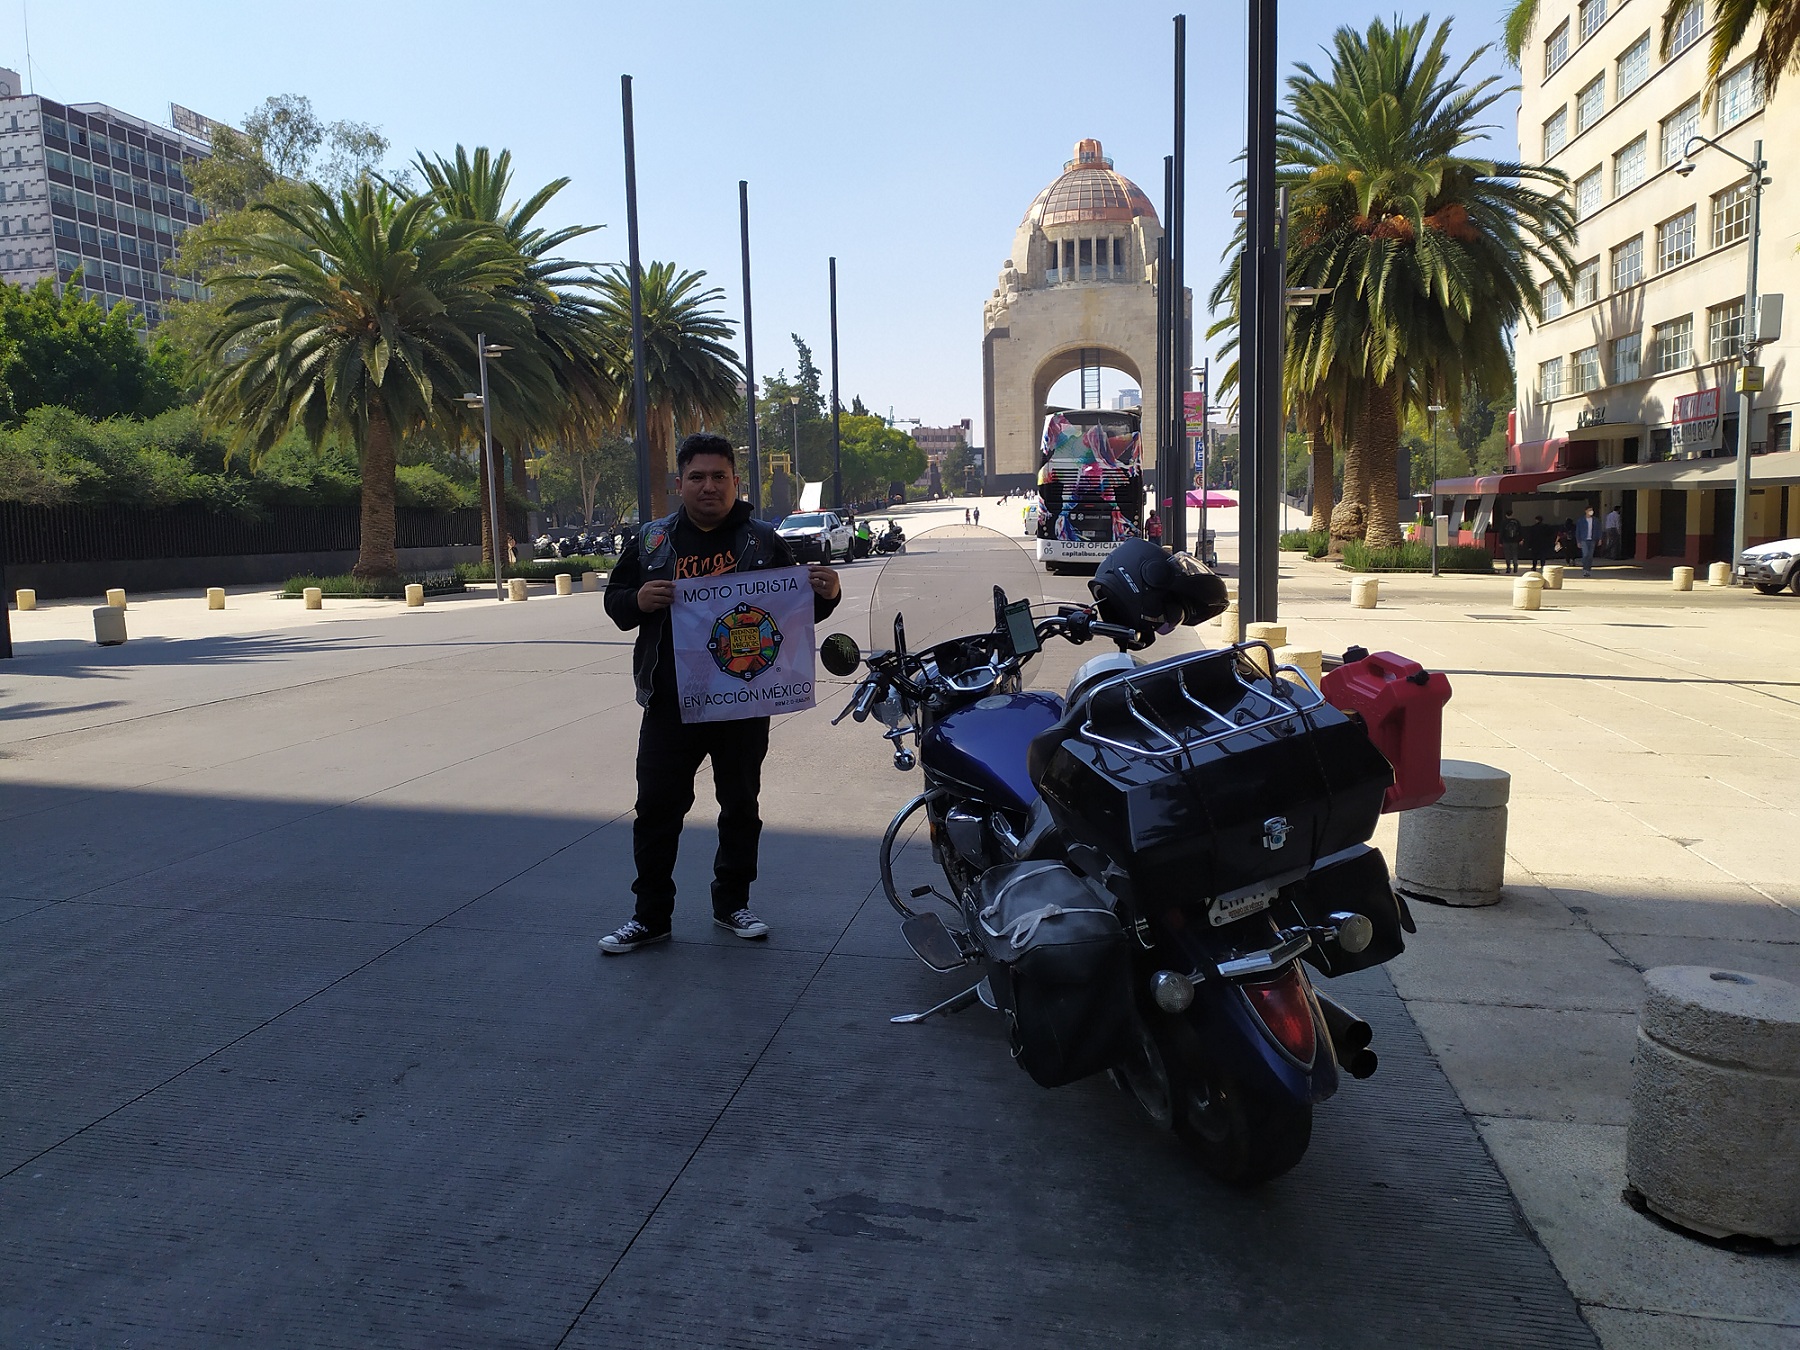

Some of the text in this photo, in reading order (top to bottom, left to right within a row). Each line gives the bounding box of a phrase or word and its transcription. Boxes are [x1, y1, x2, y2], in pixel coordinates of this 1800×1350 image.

[1043, 547, 1053, 555] 05
[1060, 541, 1086, 549] TOUR
[675, 550, 735, 581] Kings
[683, 577, 799, 603] MOTO TURISTA
[684, 681, 812, 708] EN ACCIÓN MÉXICO
